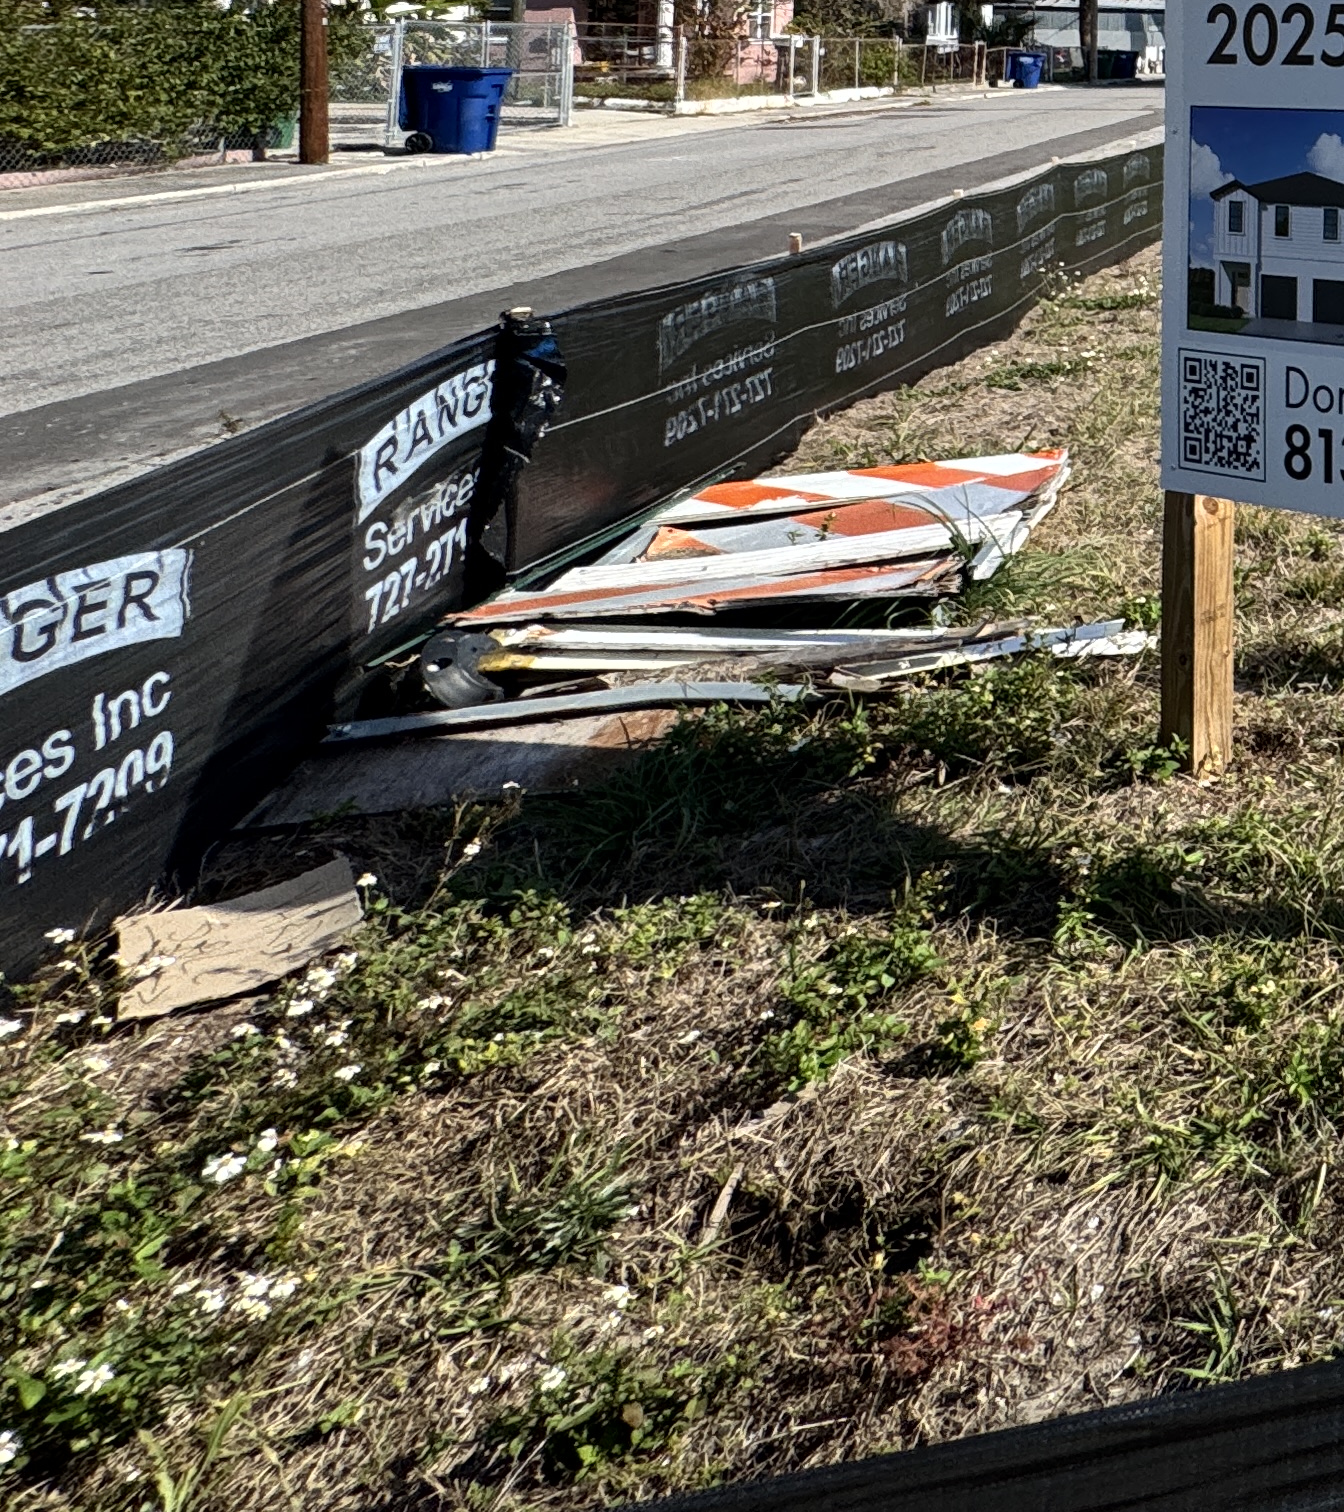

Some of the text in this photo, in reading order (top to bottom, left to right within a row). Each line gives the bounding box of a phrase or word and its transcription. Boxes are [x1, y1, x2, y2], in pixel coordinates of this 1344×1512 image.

[362, 467, 481, 571] Service
[0, 671, 172, 814] es Inc
